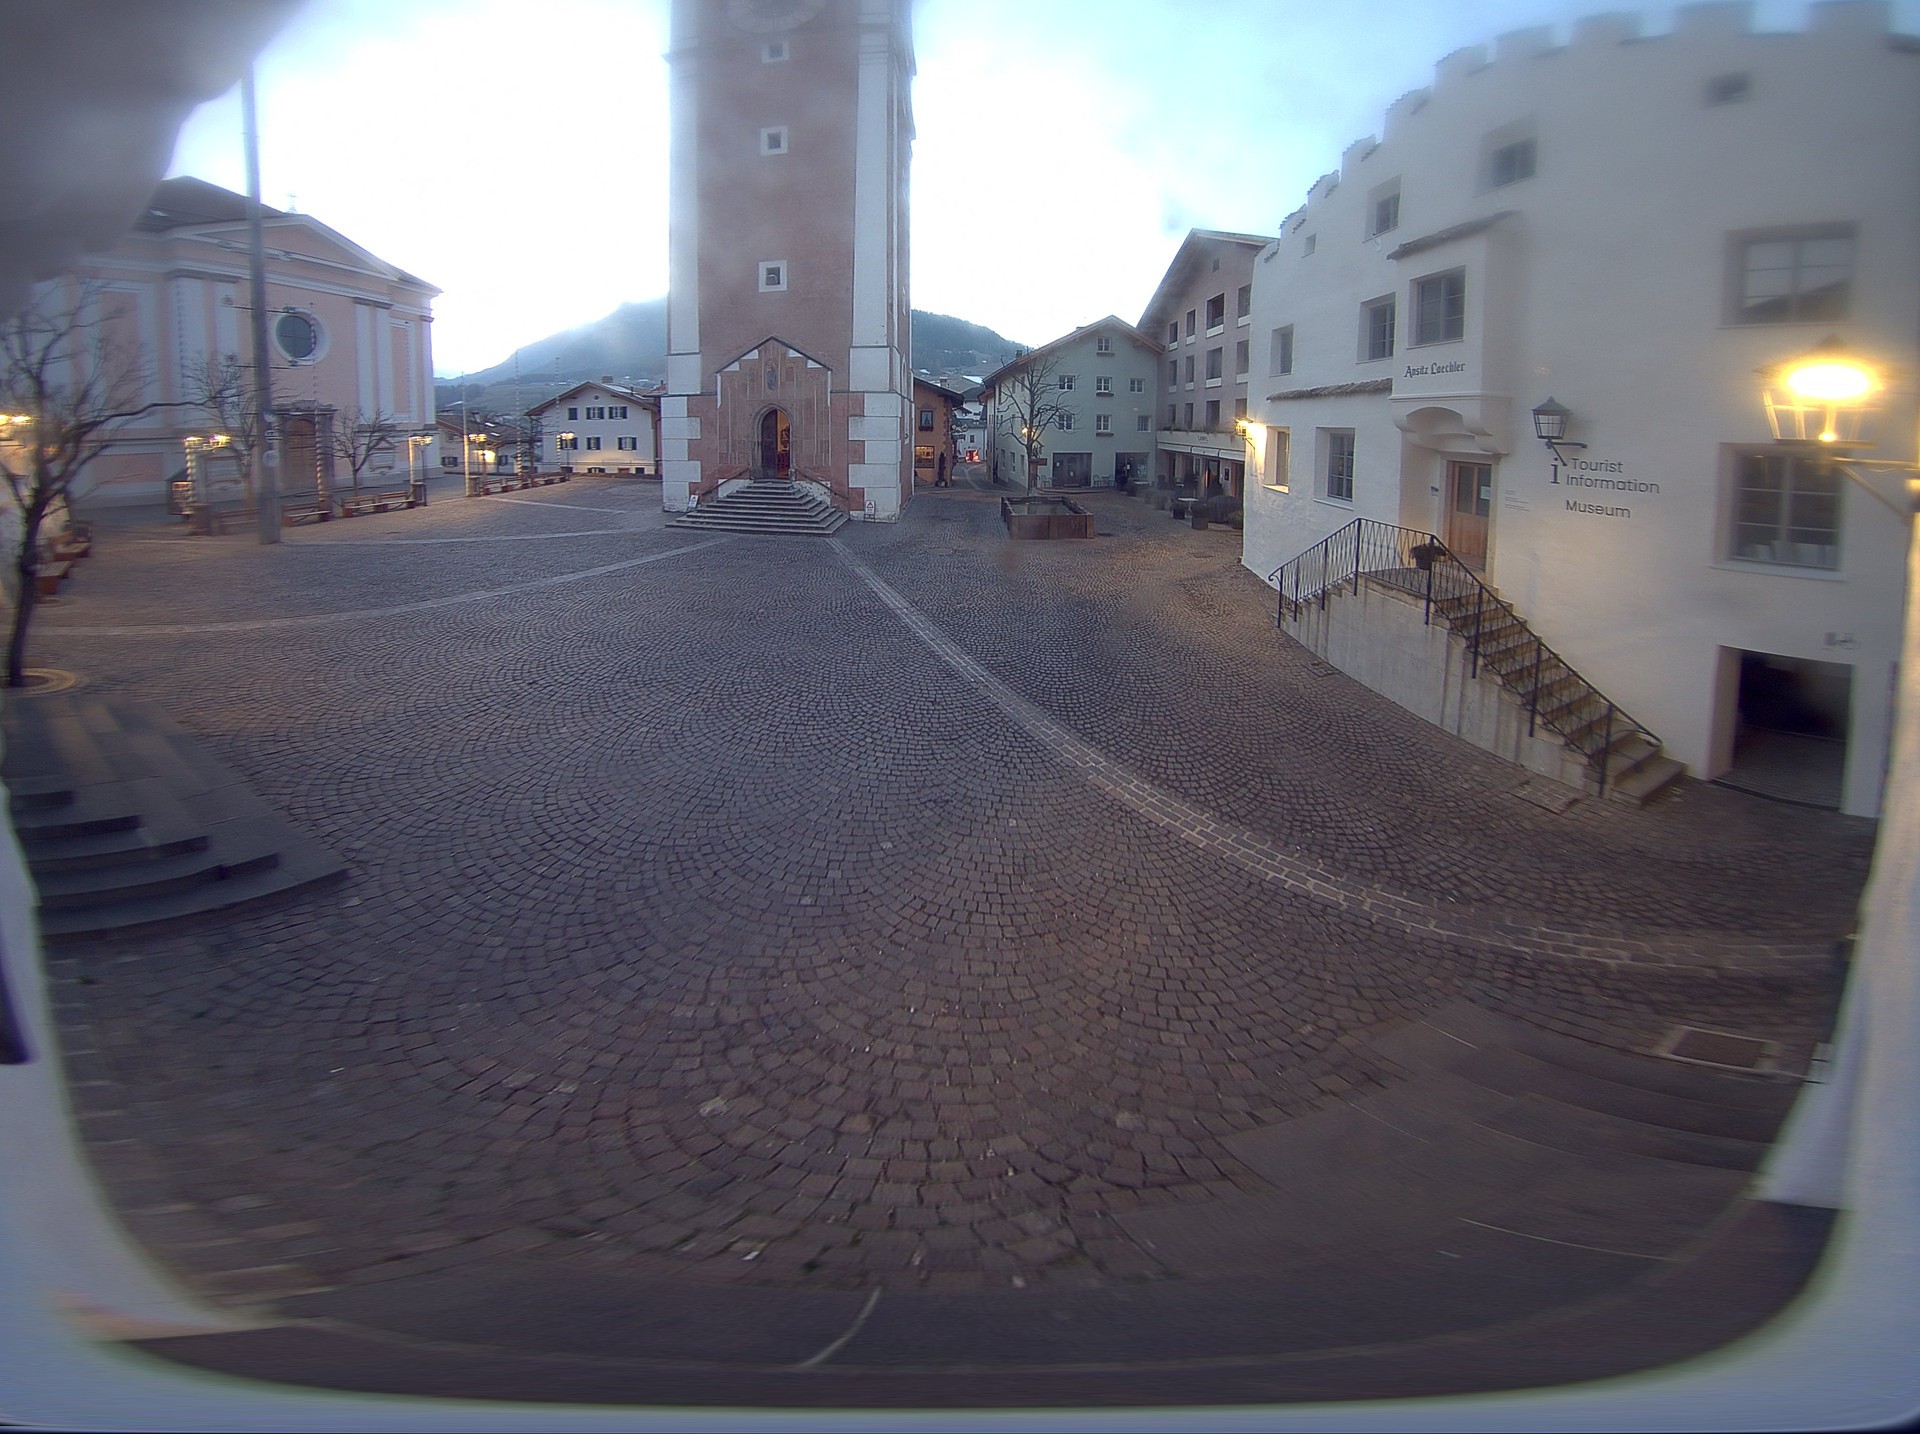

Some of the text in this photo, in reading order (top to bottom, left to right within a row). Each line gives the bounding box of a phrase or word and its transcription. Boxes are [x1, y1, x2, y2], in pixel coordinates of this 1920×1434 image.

[1403, 365, 1429, 378] Ansitz
[1571, 457, 1624, 473] Tourist
[1566, 474, 1660, 494] Information
[1566, 500, 1631, 518] Museum
